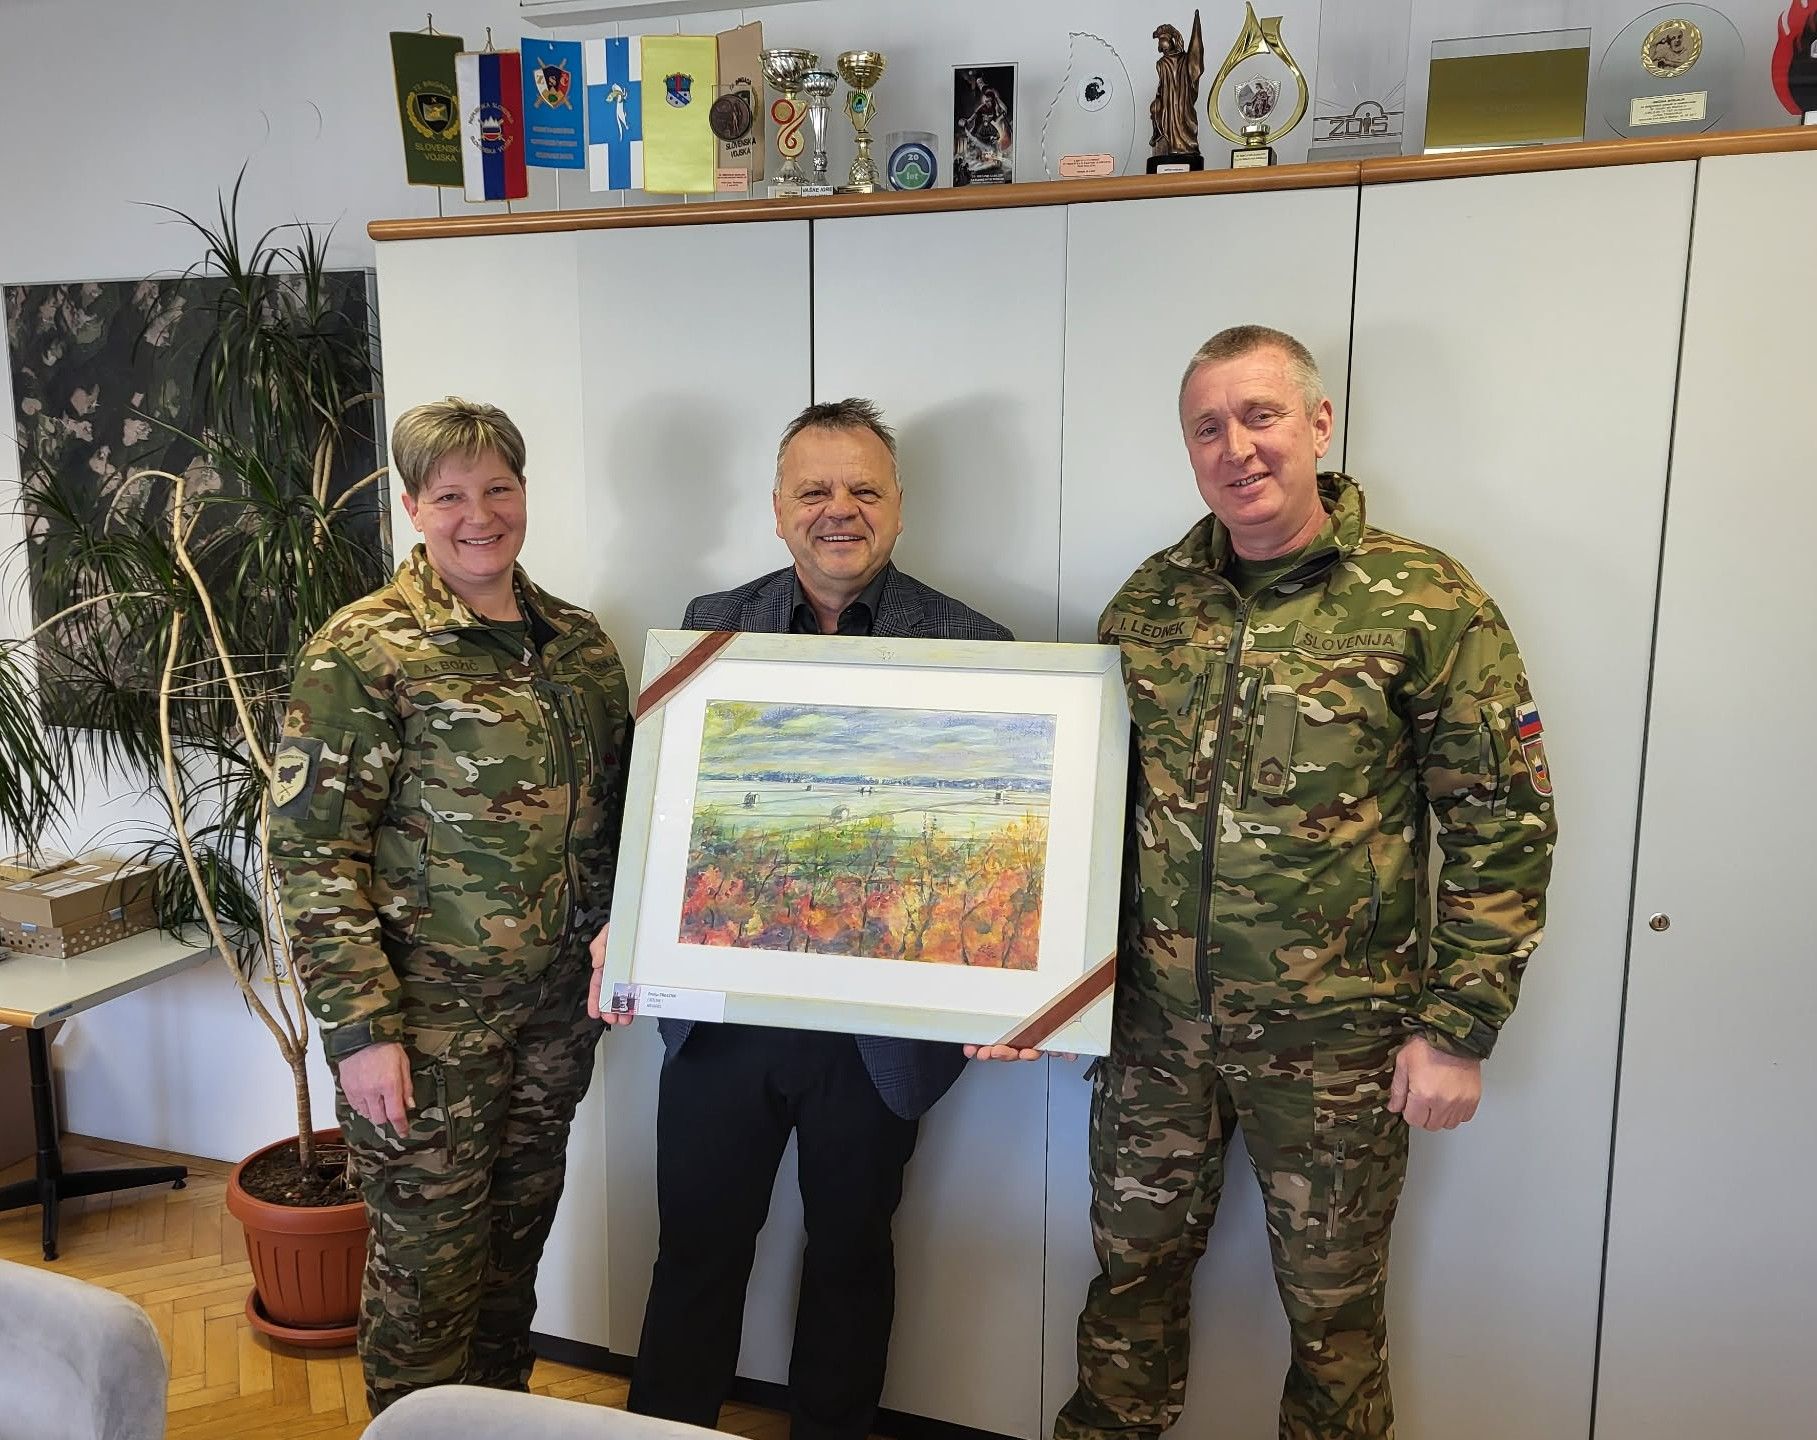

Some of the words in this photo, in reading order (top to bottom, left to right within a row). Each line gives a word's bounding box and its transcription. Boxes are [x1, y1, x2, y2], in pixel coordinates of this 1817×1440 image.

[1131, 620, 1186, 638] LEDNEK
[1303, 632, 1395, 651] SLOVENIJA
[423, 663, 438, 674] A.
